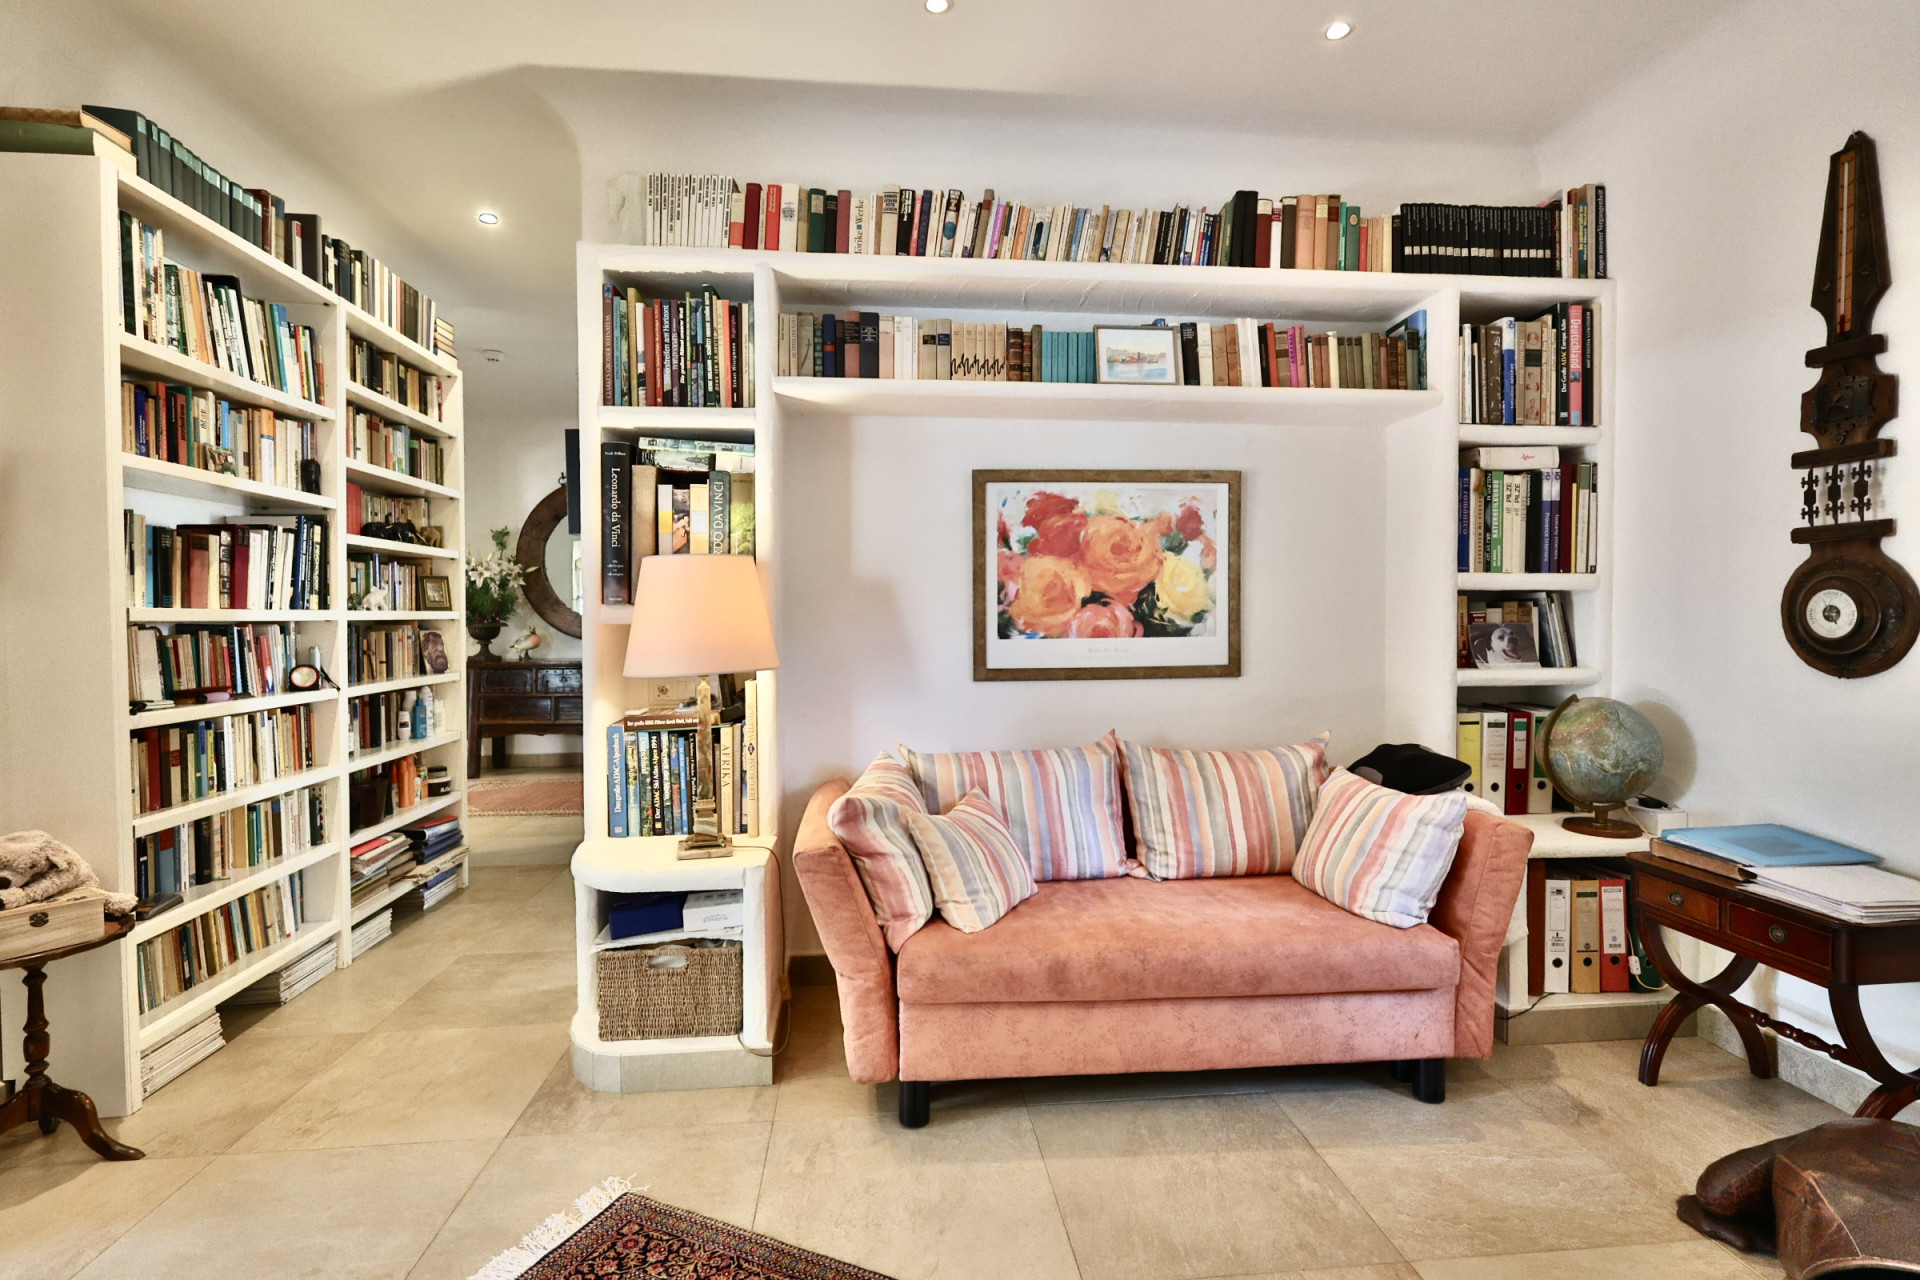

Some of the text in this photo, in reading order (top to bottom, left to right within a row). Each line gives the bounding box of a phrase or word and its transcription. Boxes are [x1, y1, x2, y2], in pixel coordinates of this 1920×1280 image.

[855, 200, 864, 225] Werke
[1571, 319, 1582, 369] Deutschland
[612, 468, 621, 548] Leonardo da Vinci
[714, 482, 724, 512] VINCI
[714, 514, 723, 529] DA
[722, 745, 730, 788] AFRIKA
[614, 785, 622, 801] große
